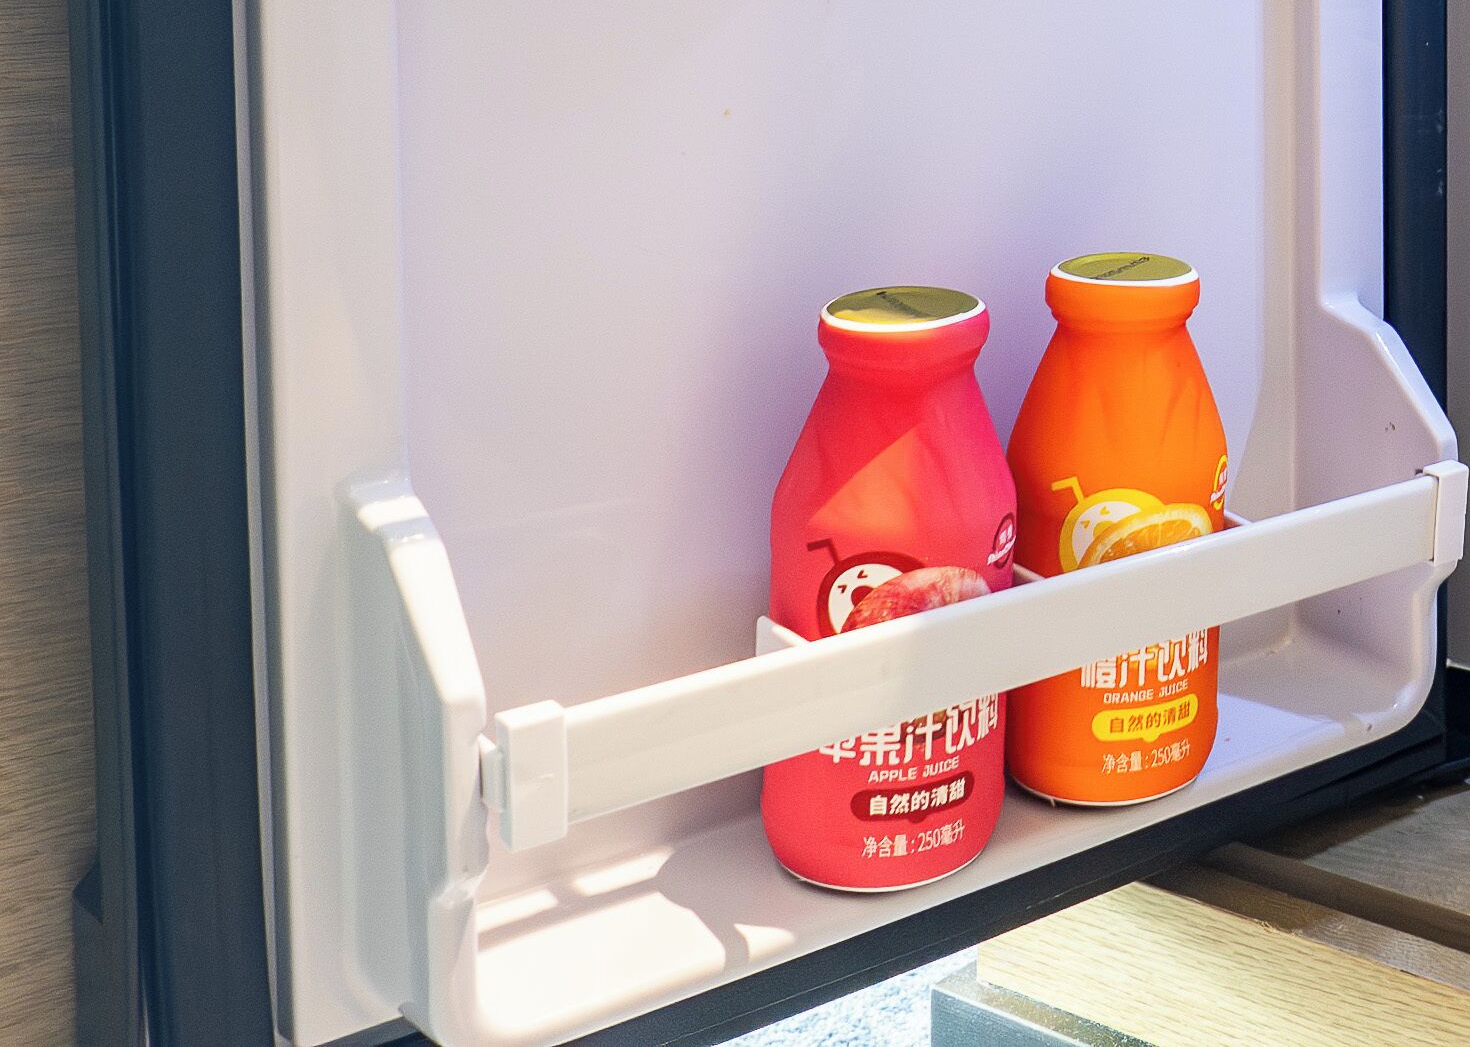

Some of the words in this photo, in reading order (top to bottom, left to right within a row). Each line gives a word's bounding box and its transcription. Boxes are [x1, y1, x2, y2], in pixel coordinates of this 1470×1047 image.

[1103, 688, 1154, 704] ORANGE
[1158, 679, 1189, 698] JUICE
[1109, 701, 1191, 734] 自然的清甜
[868, 766, 918, 784] APPLE
[922, 755, 960, 779] JUICE
[869, 776, 966, 816] 自然的清甜
